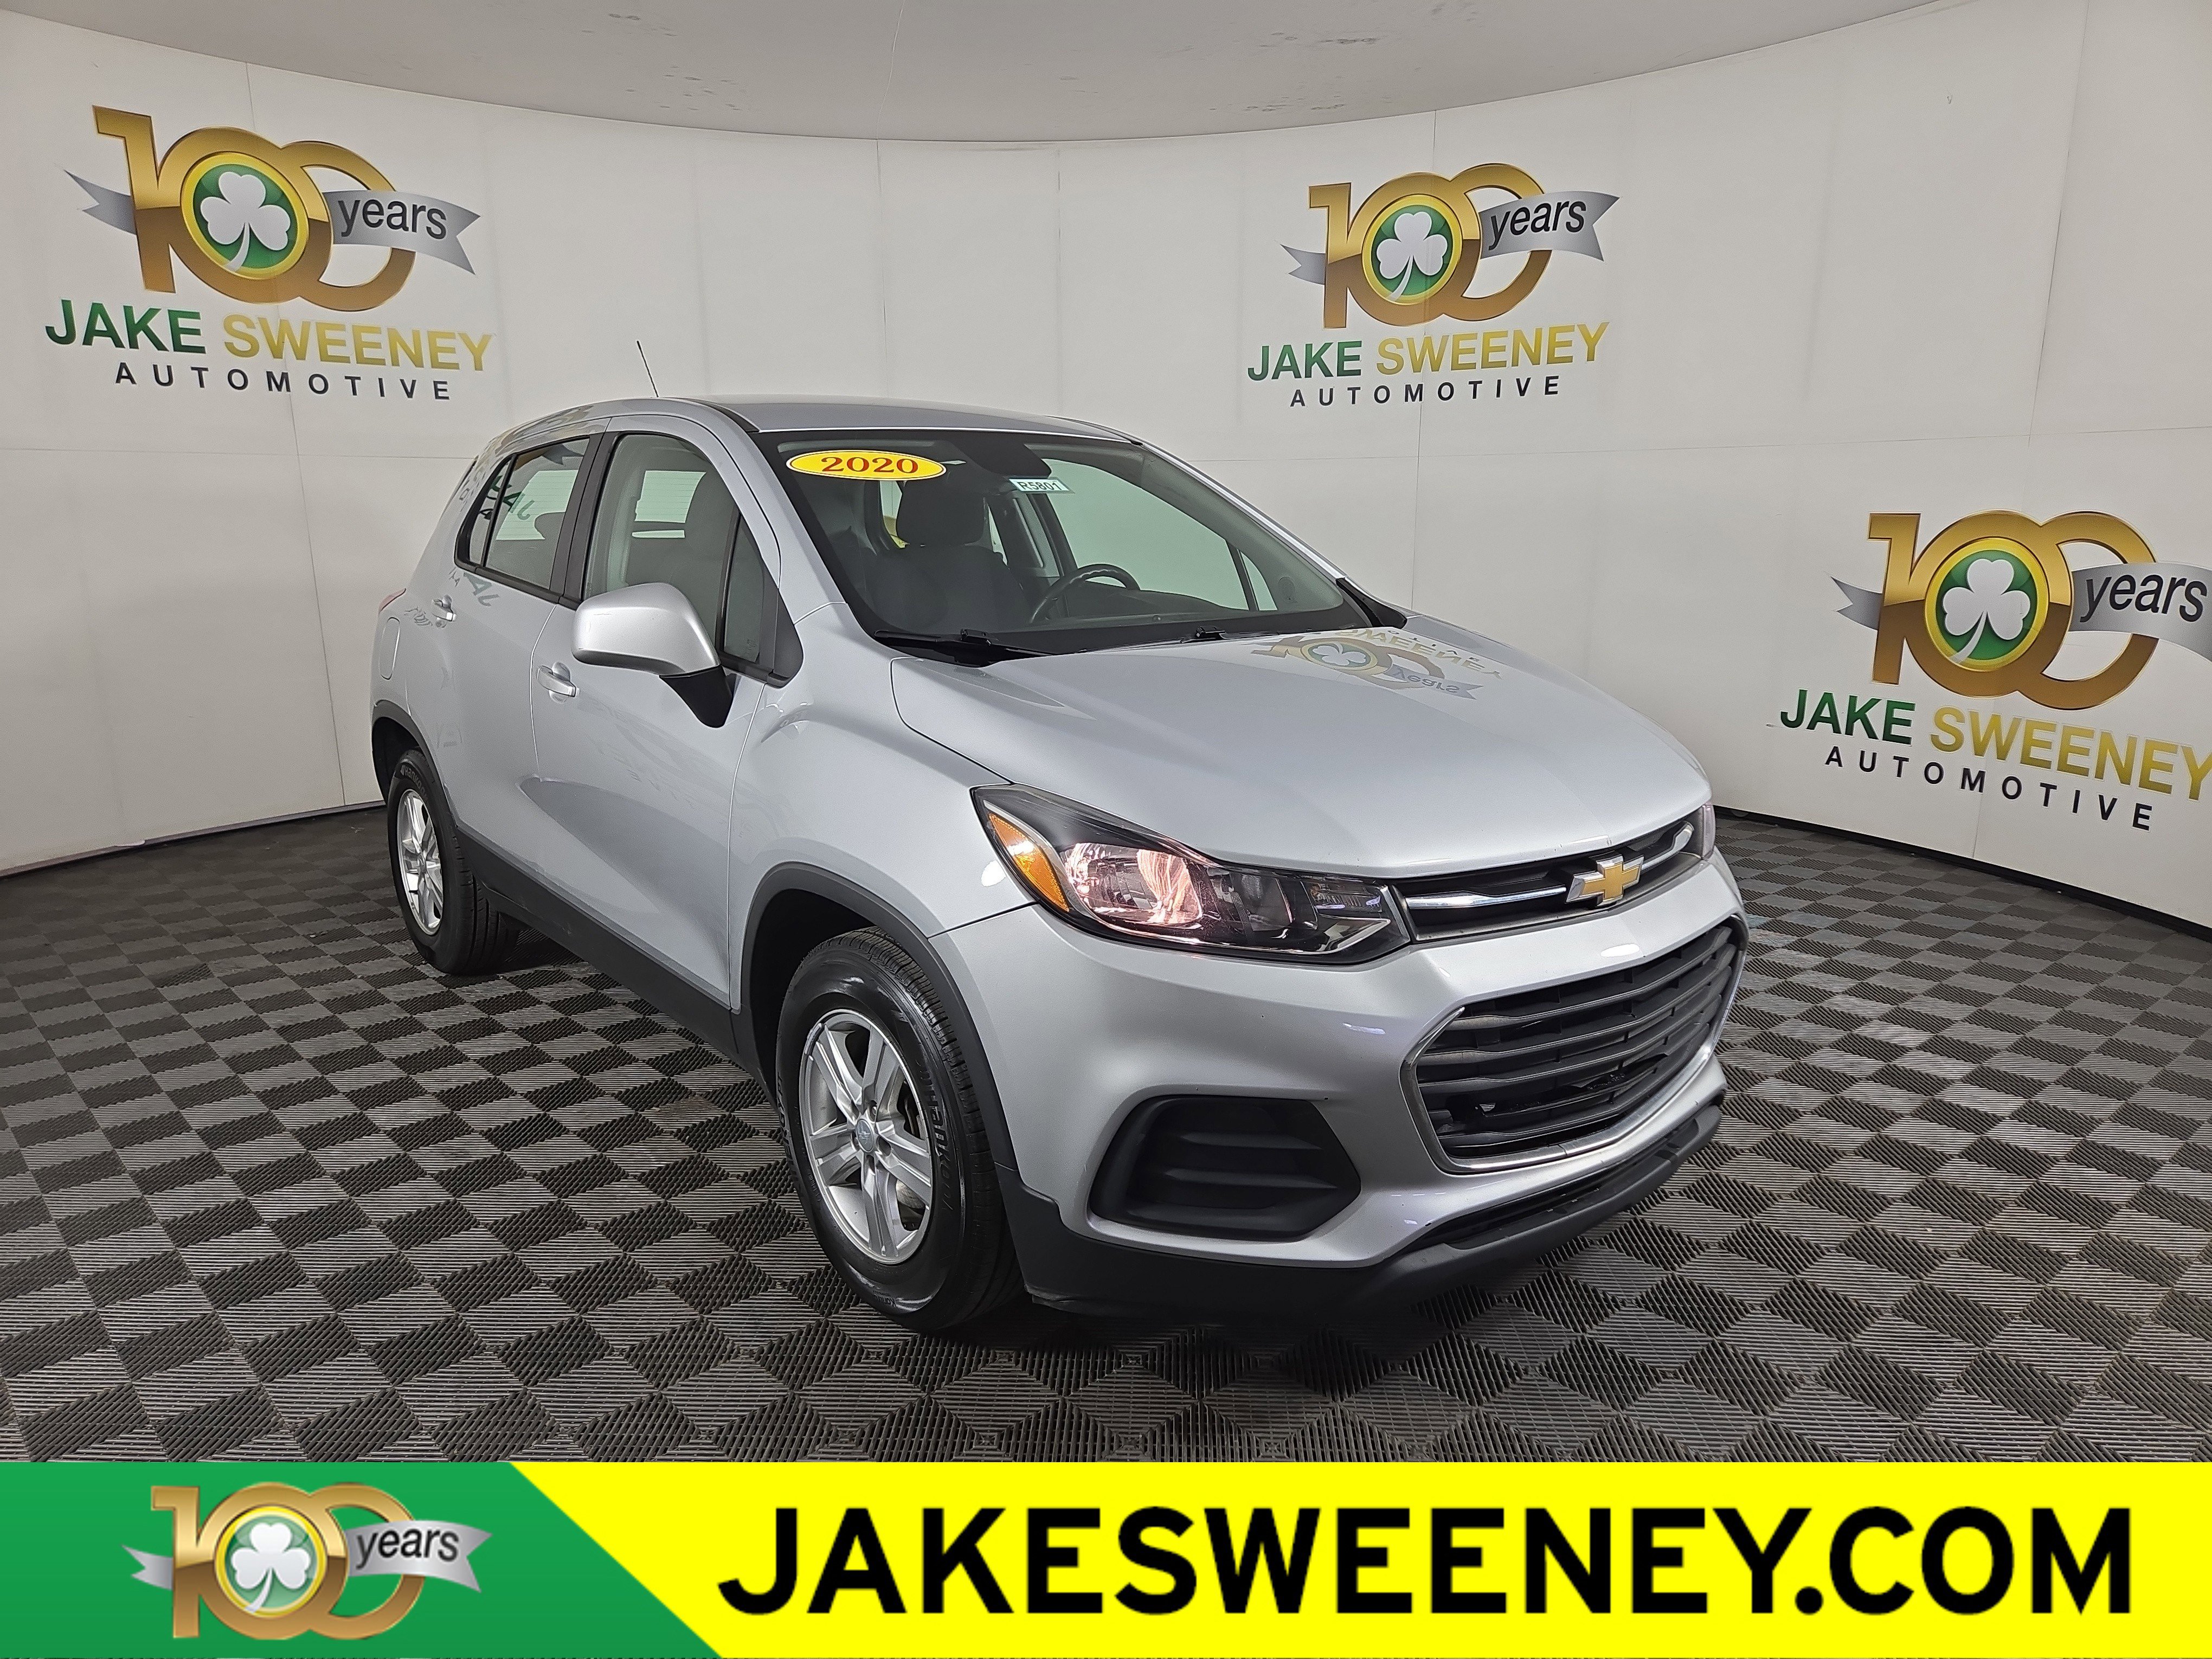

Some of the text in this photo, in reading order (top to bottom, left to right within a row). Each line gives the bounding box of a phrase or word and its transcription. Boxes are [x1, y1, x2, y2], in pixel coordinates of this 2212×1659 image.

[92, 104, 447, 313] 100 years
[1308, 163, 1587, 330] 100 years
[45, 299, 493, 372] JAKE SWEENEY
[1248, 321, 1610, 381] JAKE SWEENEY
[115, 362, 449, 400] AUTOMOTIVE
[1290, 375, 1560, 407] AUTOMOTIVE
[821, 456, 918, 474] 2020
[1016, 481, 1063, 491] R5801
[1868, 510, 2208, 711] 100 years
[1780, 688, 2212, 801] JAKE SWEENEY
[1825, 745, 2153, 831] AUTOMOTIVE
